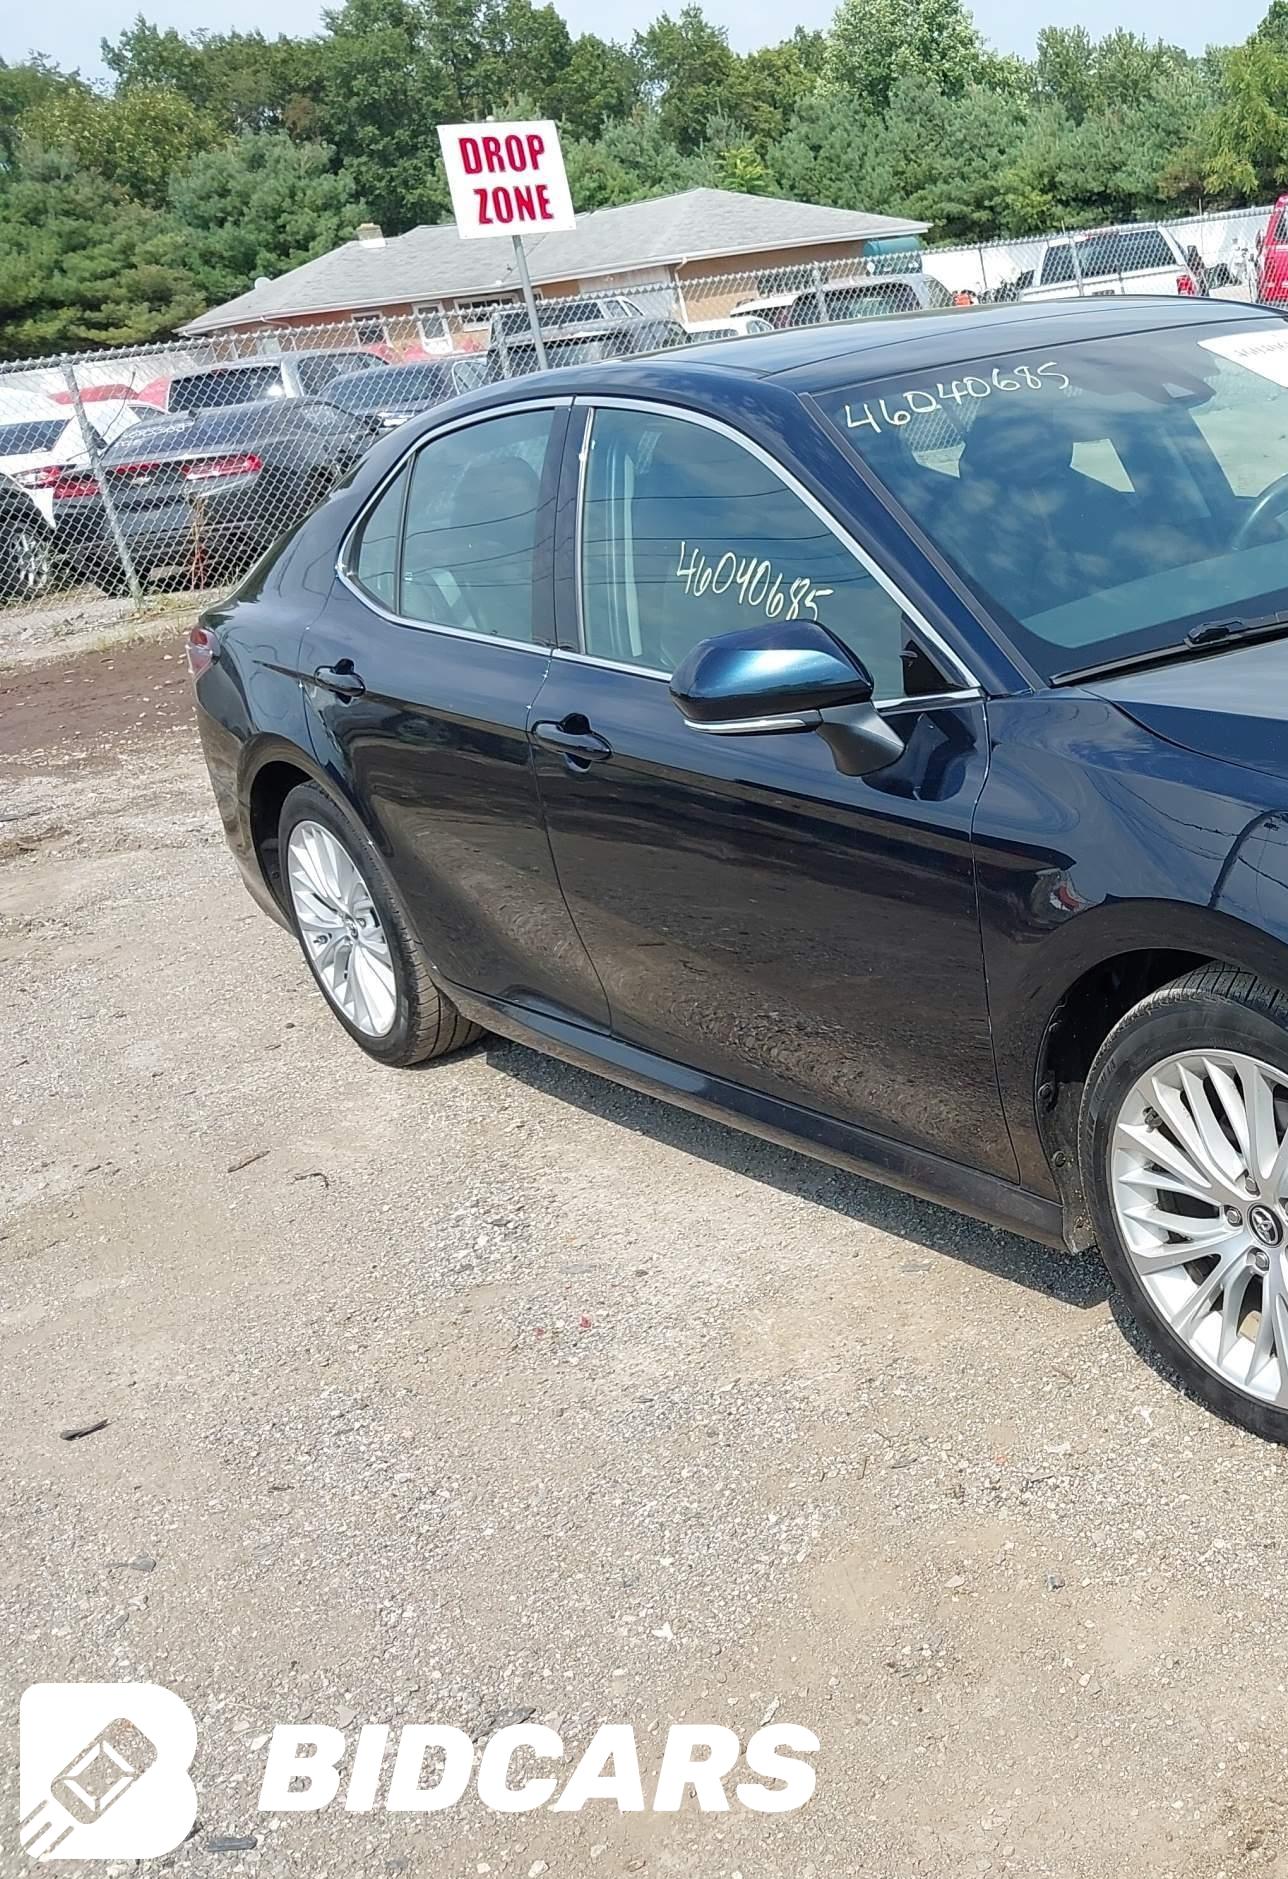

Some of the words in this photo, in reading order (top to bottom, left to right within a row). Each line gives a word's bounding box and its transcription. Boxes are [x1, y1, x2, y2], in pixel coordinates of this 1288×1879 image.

[458, 134, 545, 175] DROP
[473, 184, 554, 225] ZONE
[844, 361, 1070, 433] 46040685
[676, 540, 834, 621] 46040685
